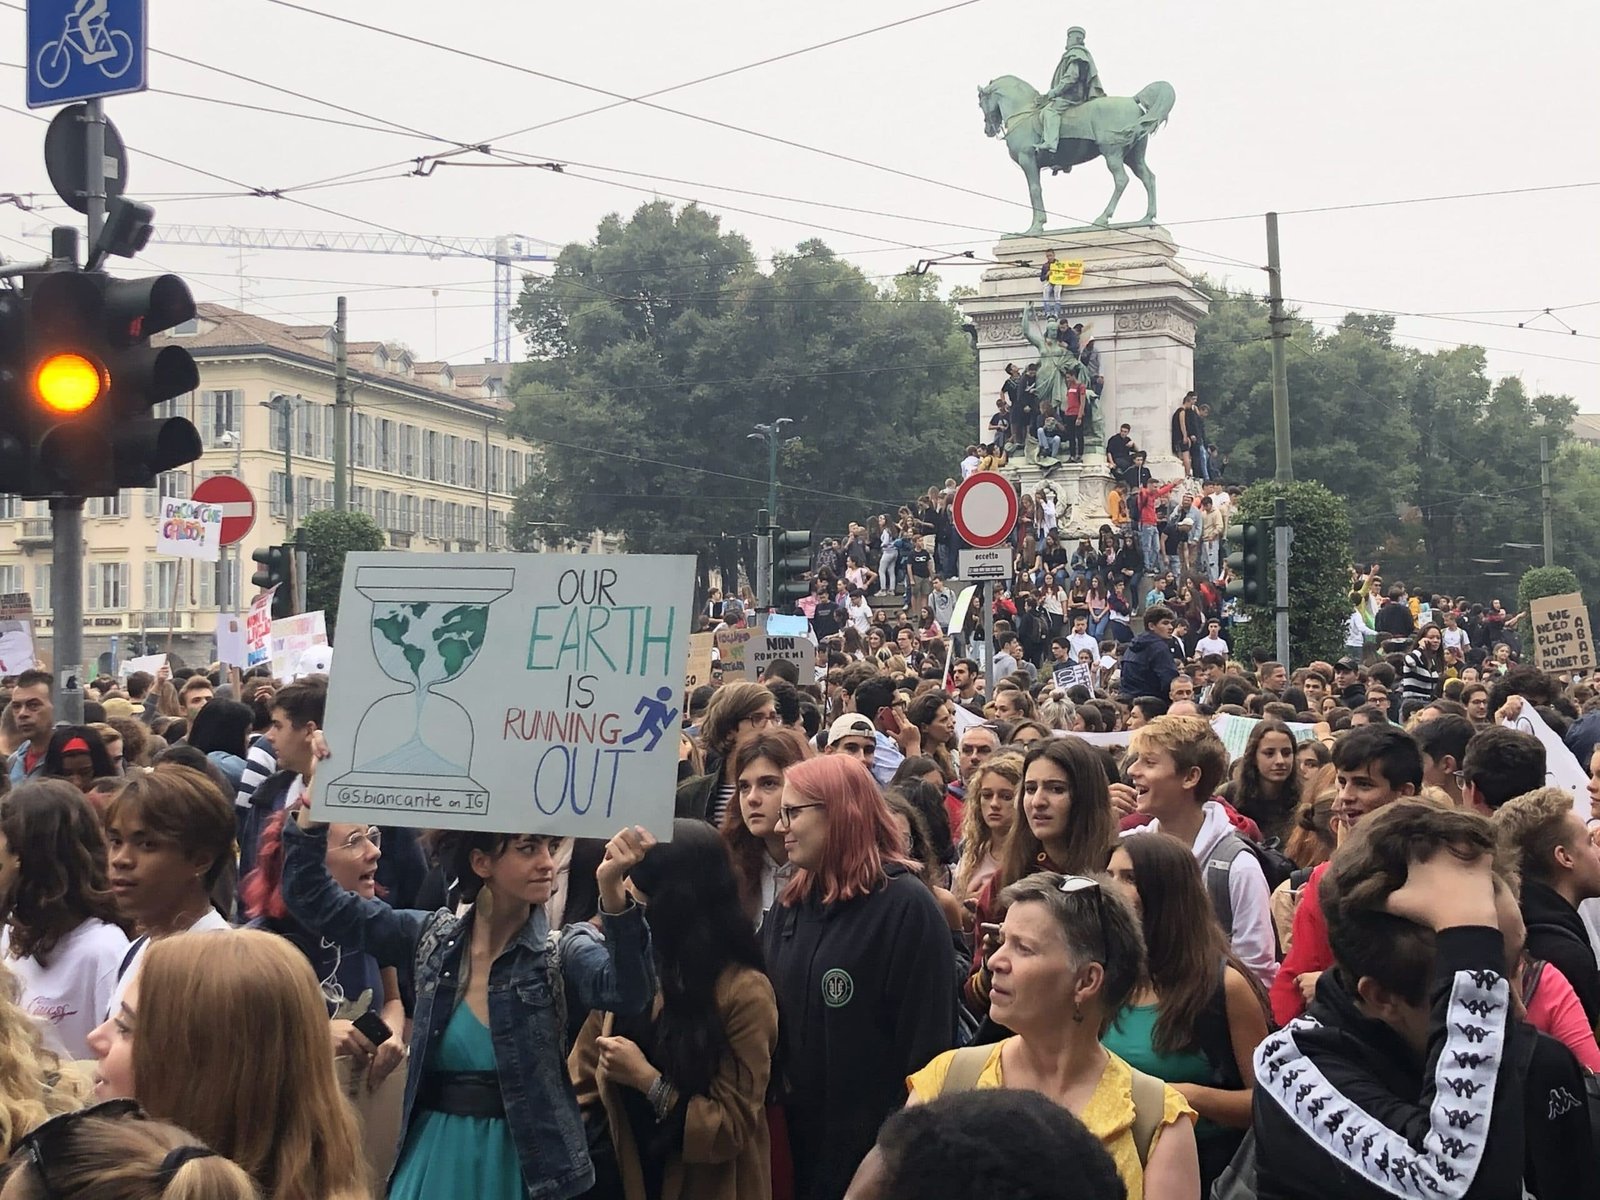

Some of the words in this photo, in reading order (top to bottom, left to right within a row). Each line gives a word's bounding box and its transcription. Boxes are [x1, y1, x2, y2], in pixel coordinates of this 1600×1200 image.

[975, 552, 999, 560] eccetto
[558, 568, 618, 606] OUR
[1548, 610, 1570, 620] WE
[1536, 621, 1568, 634] NEED
[1575, 617, 1583, 627] A
[527, 605, 675, 676] EARTH
[766, 637, 795, 651] NON
[1538, 633, 1573, 645] PLAN
[1577, 629, 1585, 639] B
[754, 651, 804, 661] ROMPERMI
[1543, 645, 1565, 657] NOT
[1579, 641, 1588, 652] A
[1543, 656, 1577, 669] PLANET
[1581, 655, 1590, 666] B
[566, 674, 599, 708] IS
[503, 707, 622, 745] RUNNING
[534, 745, 637, 818] OUT
[449, 800, 461, 808] on
[465, 793, 484, 809] IG
